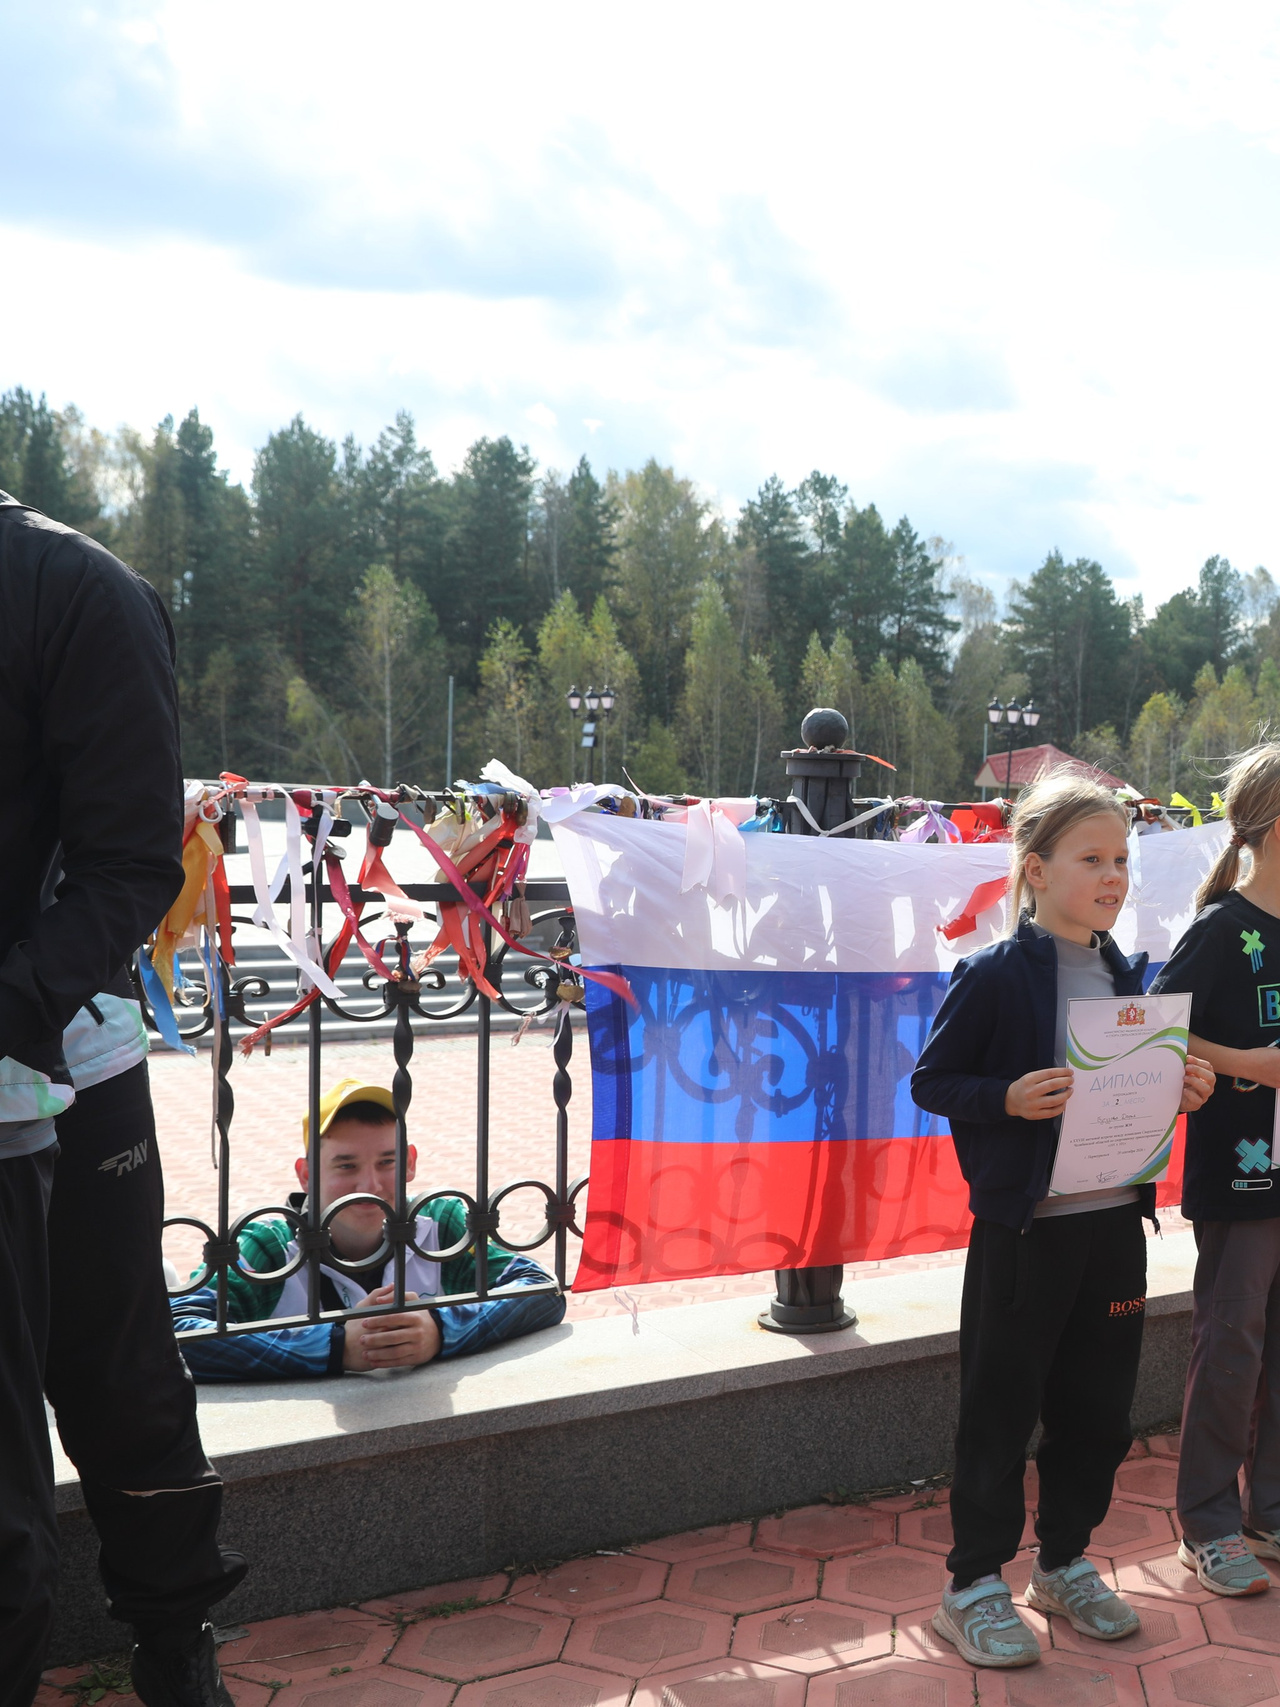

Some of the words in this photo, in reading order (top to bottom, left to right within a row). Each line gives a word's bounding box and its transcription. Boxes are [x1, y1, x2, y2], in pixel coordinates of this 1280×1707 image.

[1089, 1071, 1162, 1093] ДИПЛОМ
[1124, 1097, 1146, 1105] МЕСТО
[1110, 1294, 1147, 1314] BOSS
